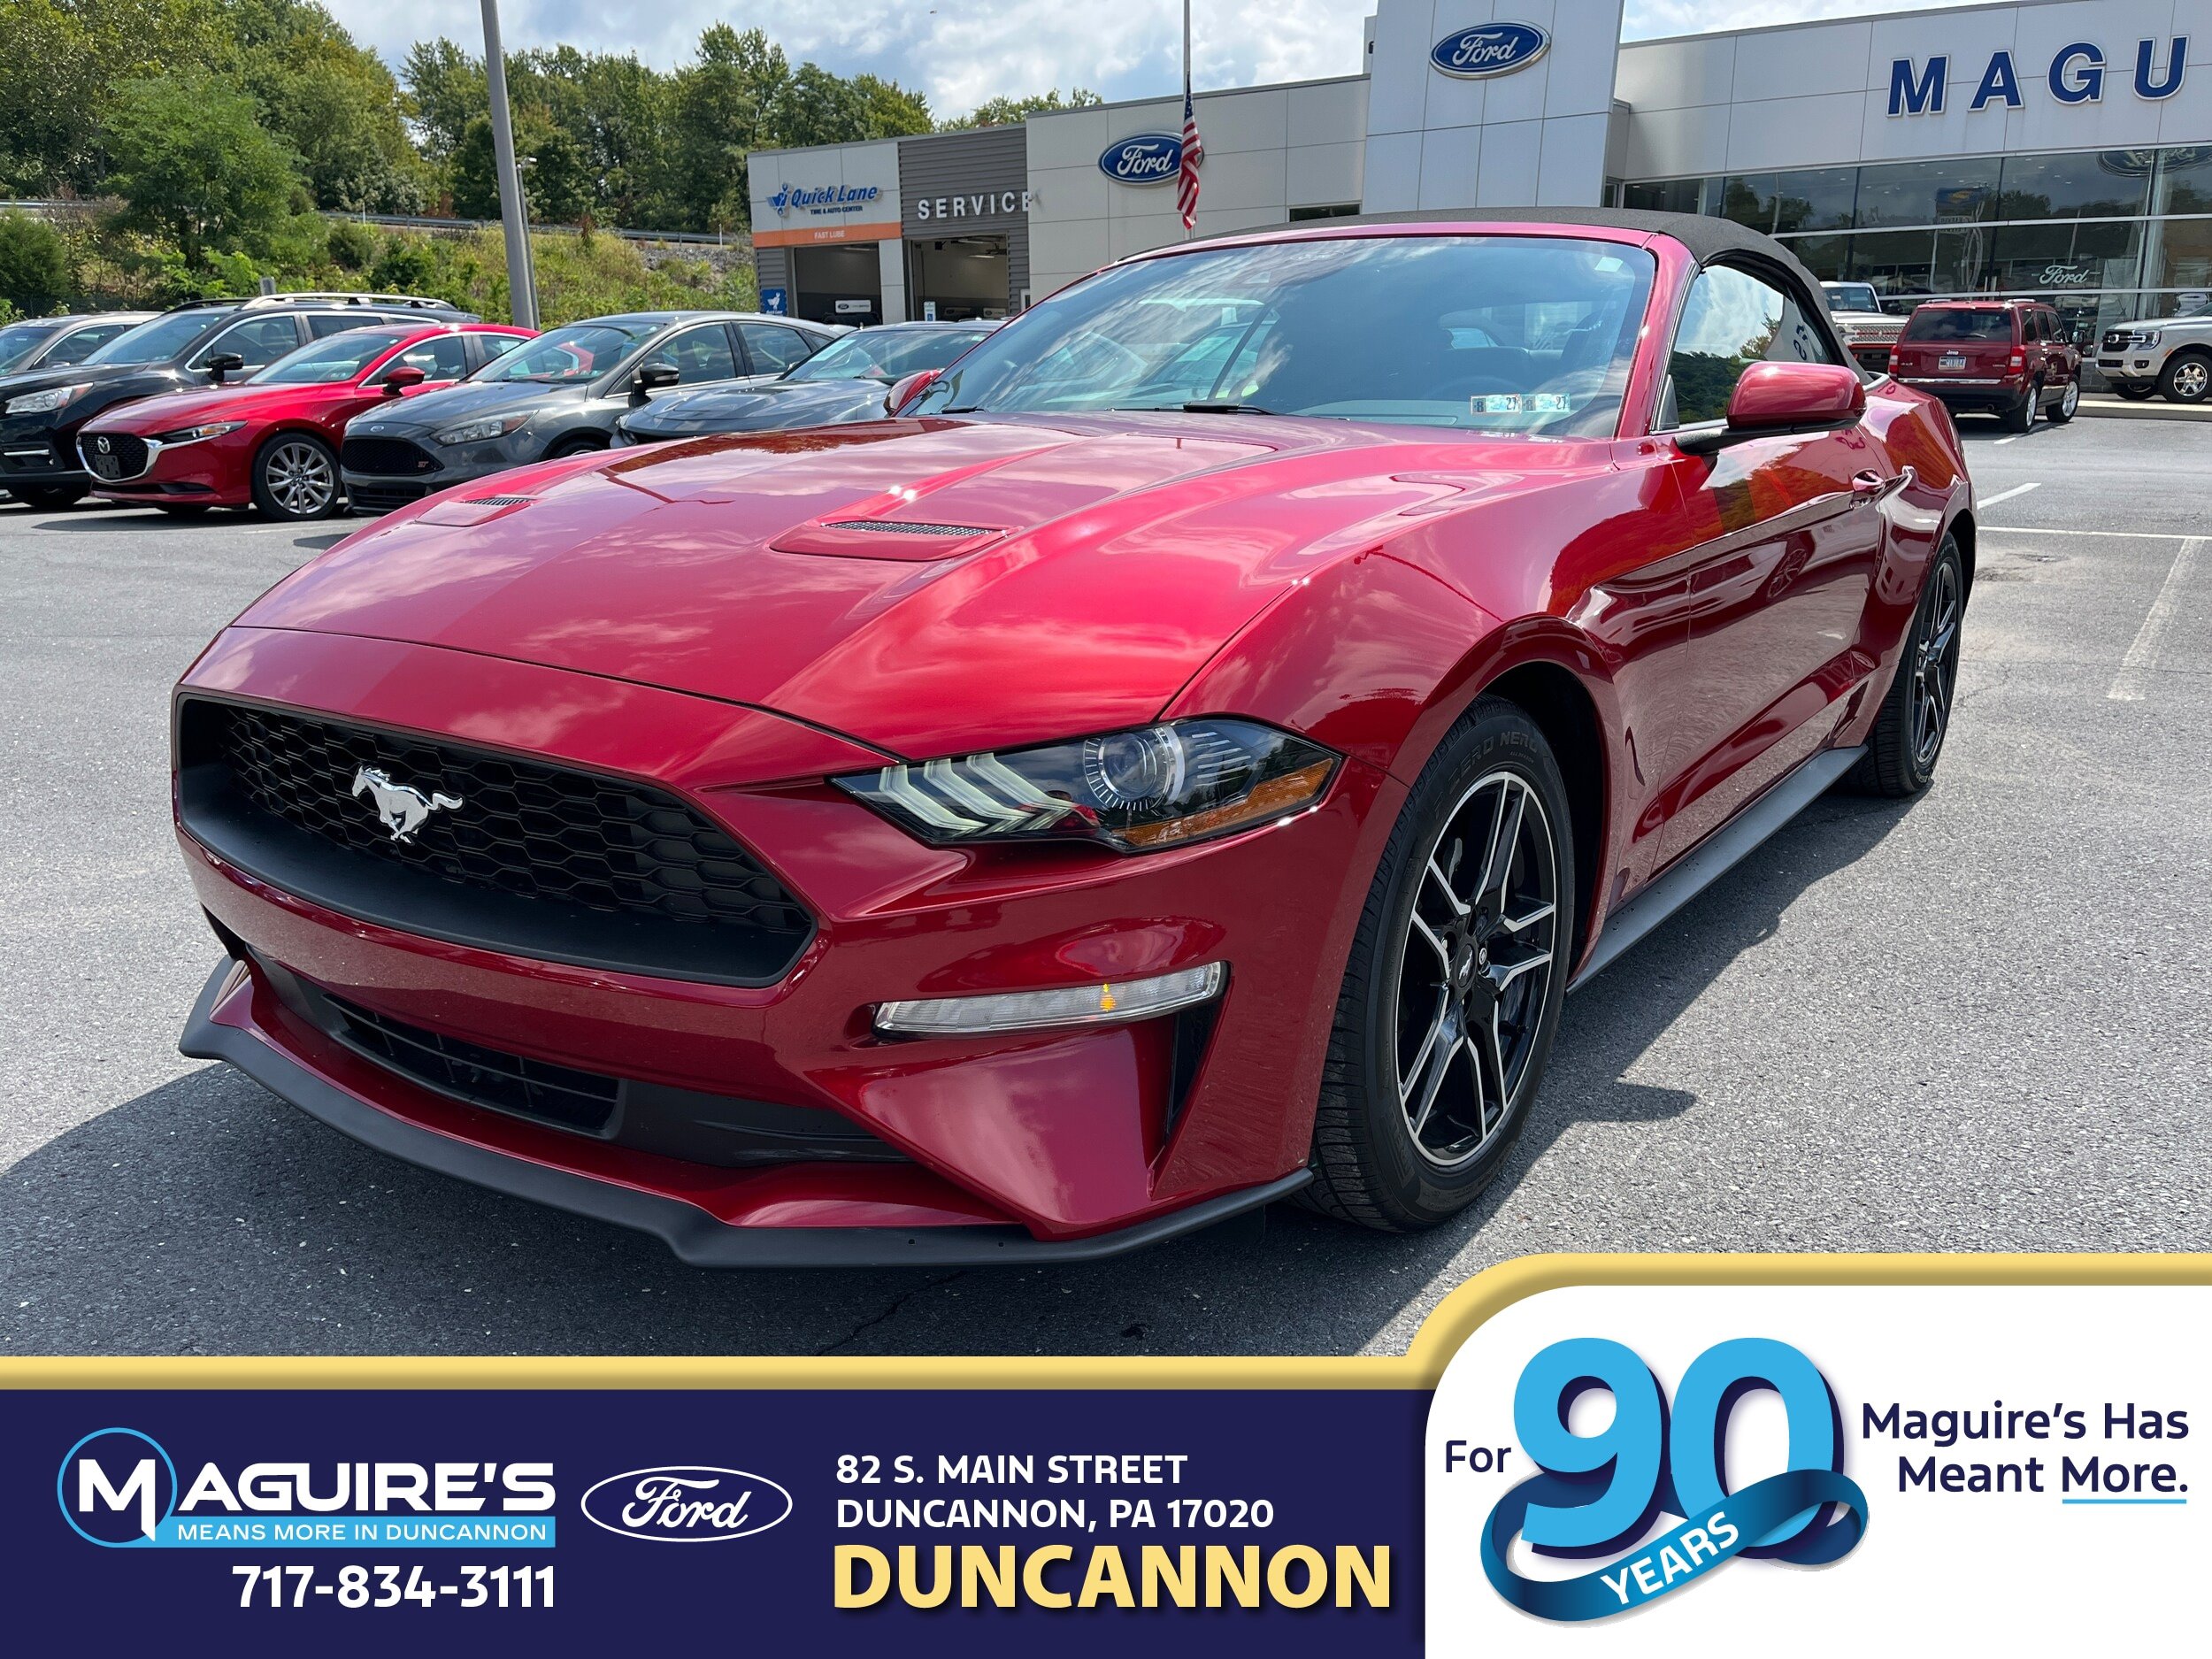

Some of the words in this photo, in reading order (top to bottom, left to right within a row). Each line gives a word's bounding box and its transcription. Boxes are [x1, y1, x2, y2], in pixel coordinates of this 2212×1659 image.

[1452, 32, 1519, 65] Ford
[1886, 35, 2190, 118] MAGU
[1117, 143, 1173, 175] Ford
[791, 186, 834, 208] Quick
[837, 185, 879, 203] Lane
[829, 230, 845, 239] LUBE
[2039, 265, 2089, 284] Ford
[1506, 396, 1517, 411] 27
[1555, 396, 1566, 410] 27
